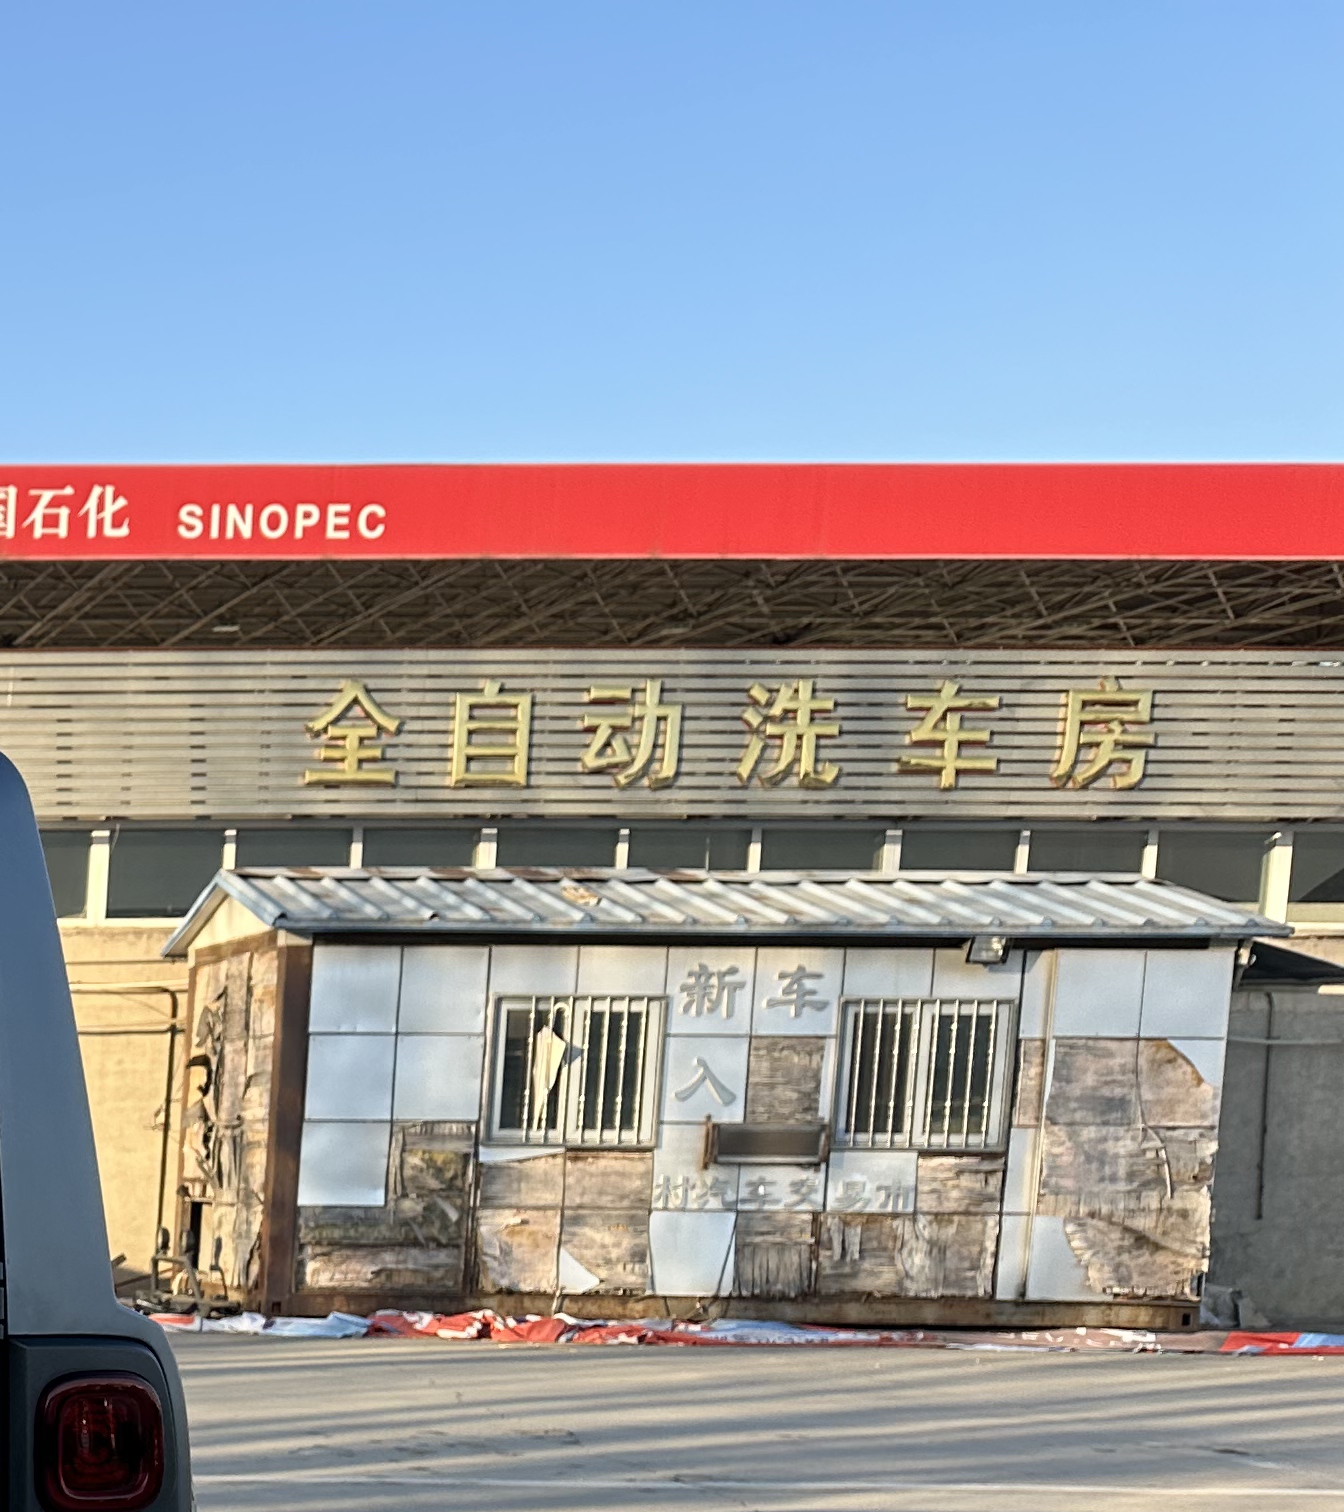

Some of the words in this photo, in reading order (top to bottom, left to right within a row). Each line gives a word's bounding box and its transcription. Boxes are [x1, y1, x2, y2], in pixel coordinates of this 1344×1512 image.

[177, 502, 387, 540] SINOPEC
[304, 677, 1155, 790] 全自动洗车房
[679, 962, 830, 1020] 新车
